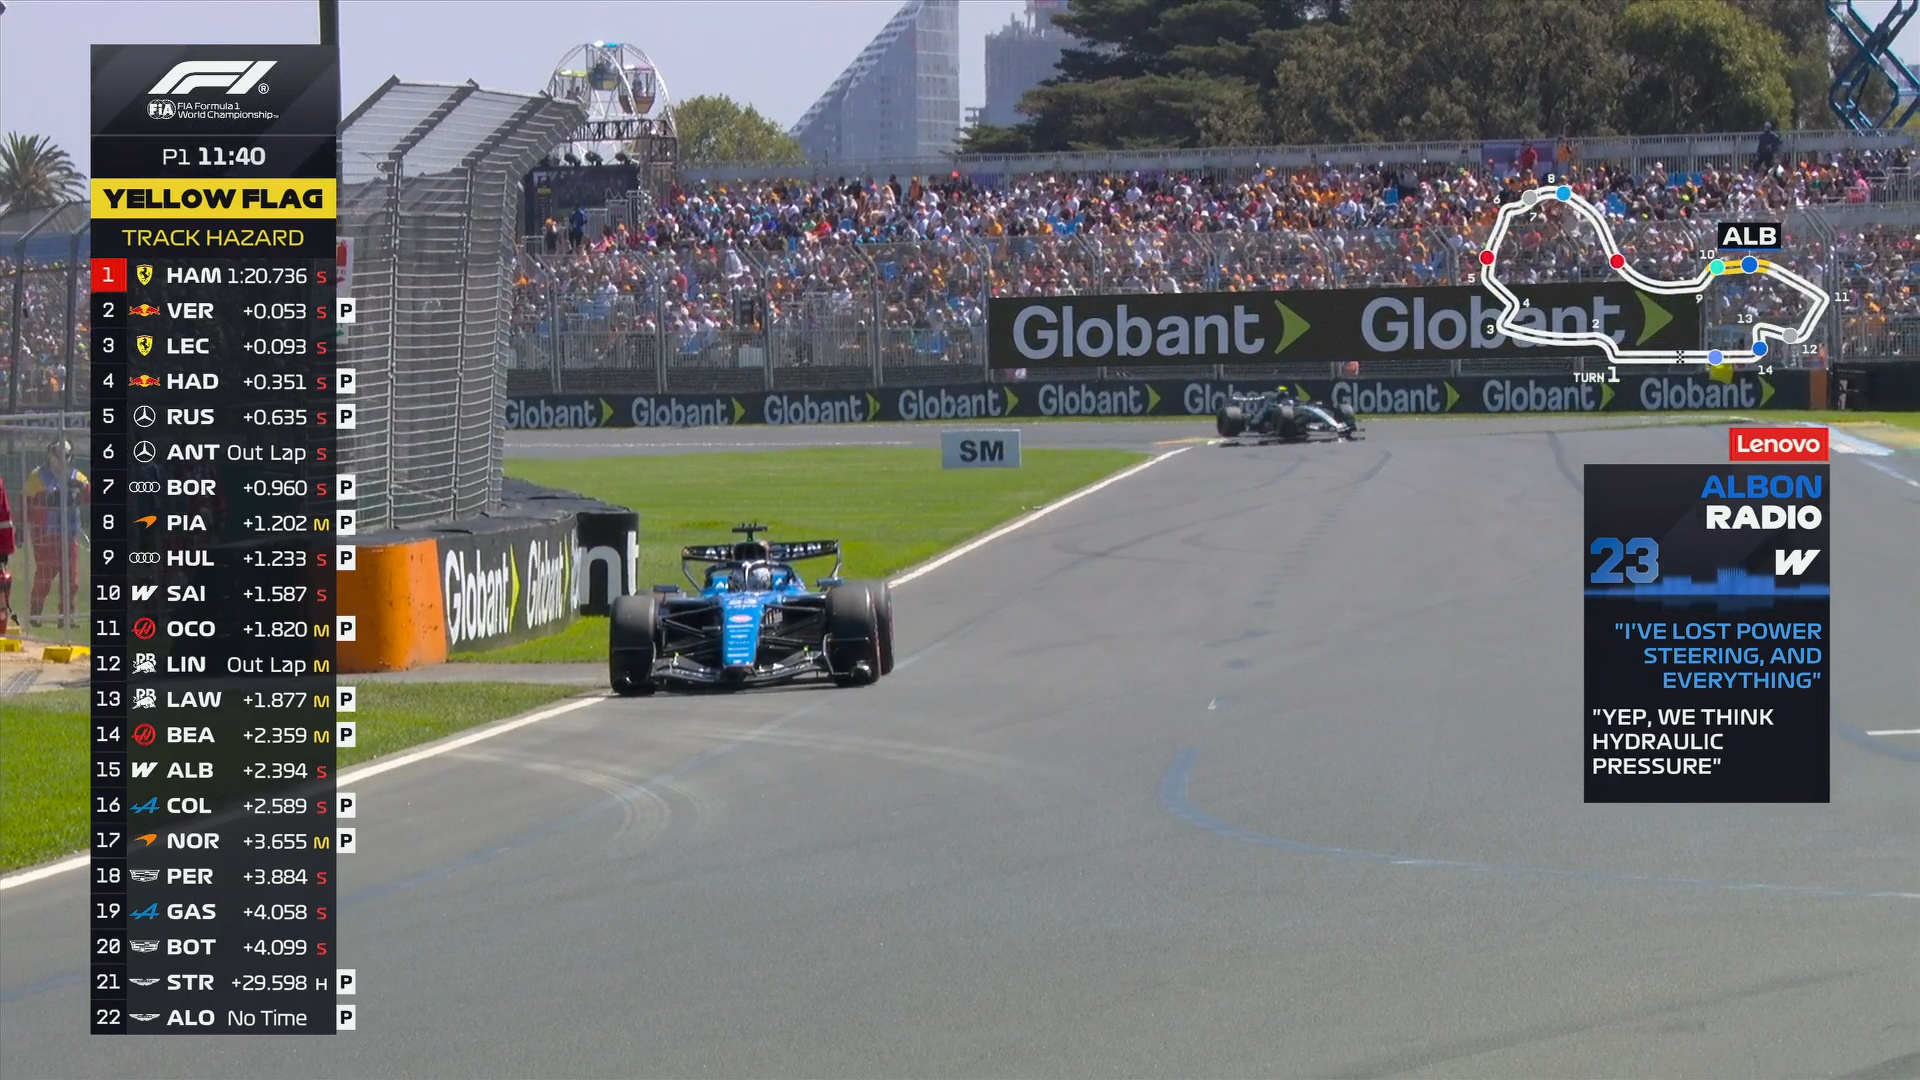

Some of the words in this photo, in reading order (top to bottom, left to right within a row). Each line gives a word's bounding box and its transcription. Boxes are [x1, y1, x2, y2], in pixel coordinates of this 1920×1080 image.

[1013, 304, 1266, 360] Globant
[1361, 297, 1625, 352] Globant
[899, 388, 999, 420] Globant
[1038, 384, 1142, 416] Globant
[1331, 381, 1441, 413] Globant
[1482, 379, 1595, 412] Globant
[1640, 375, 1755, 409] Globant
[505, 399, 597, 429] Globant
[631, 397, 729, 427] Globant
[764, 394, 863, 425] Globant
[959, 440, 1004, 462] SM
[445, 549, 509, 646] Globant
[526, 539, 564, 629] Globant
